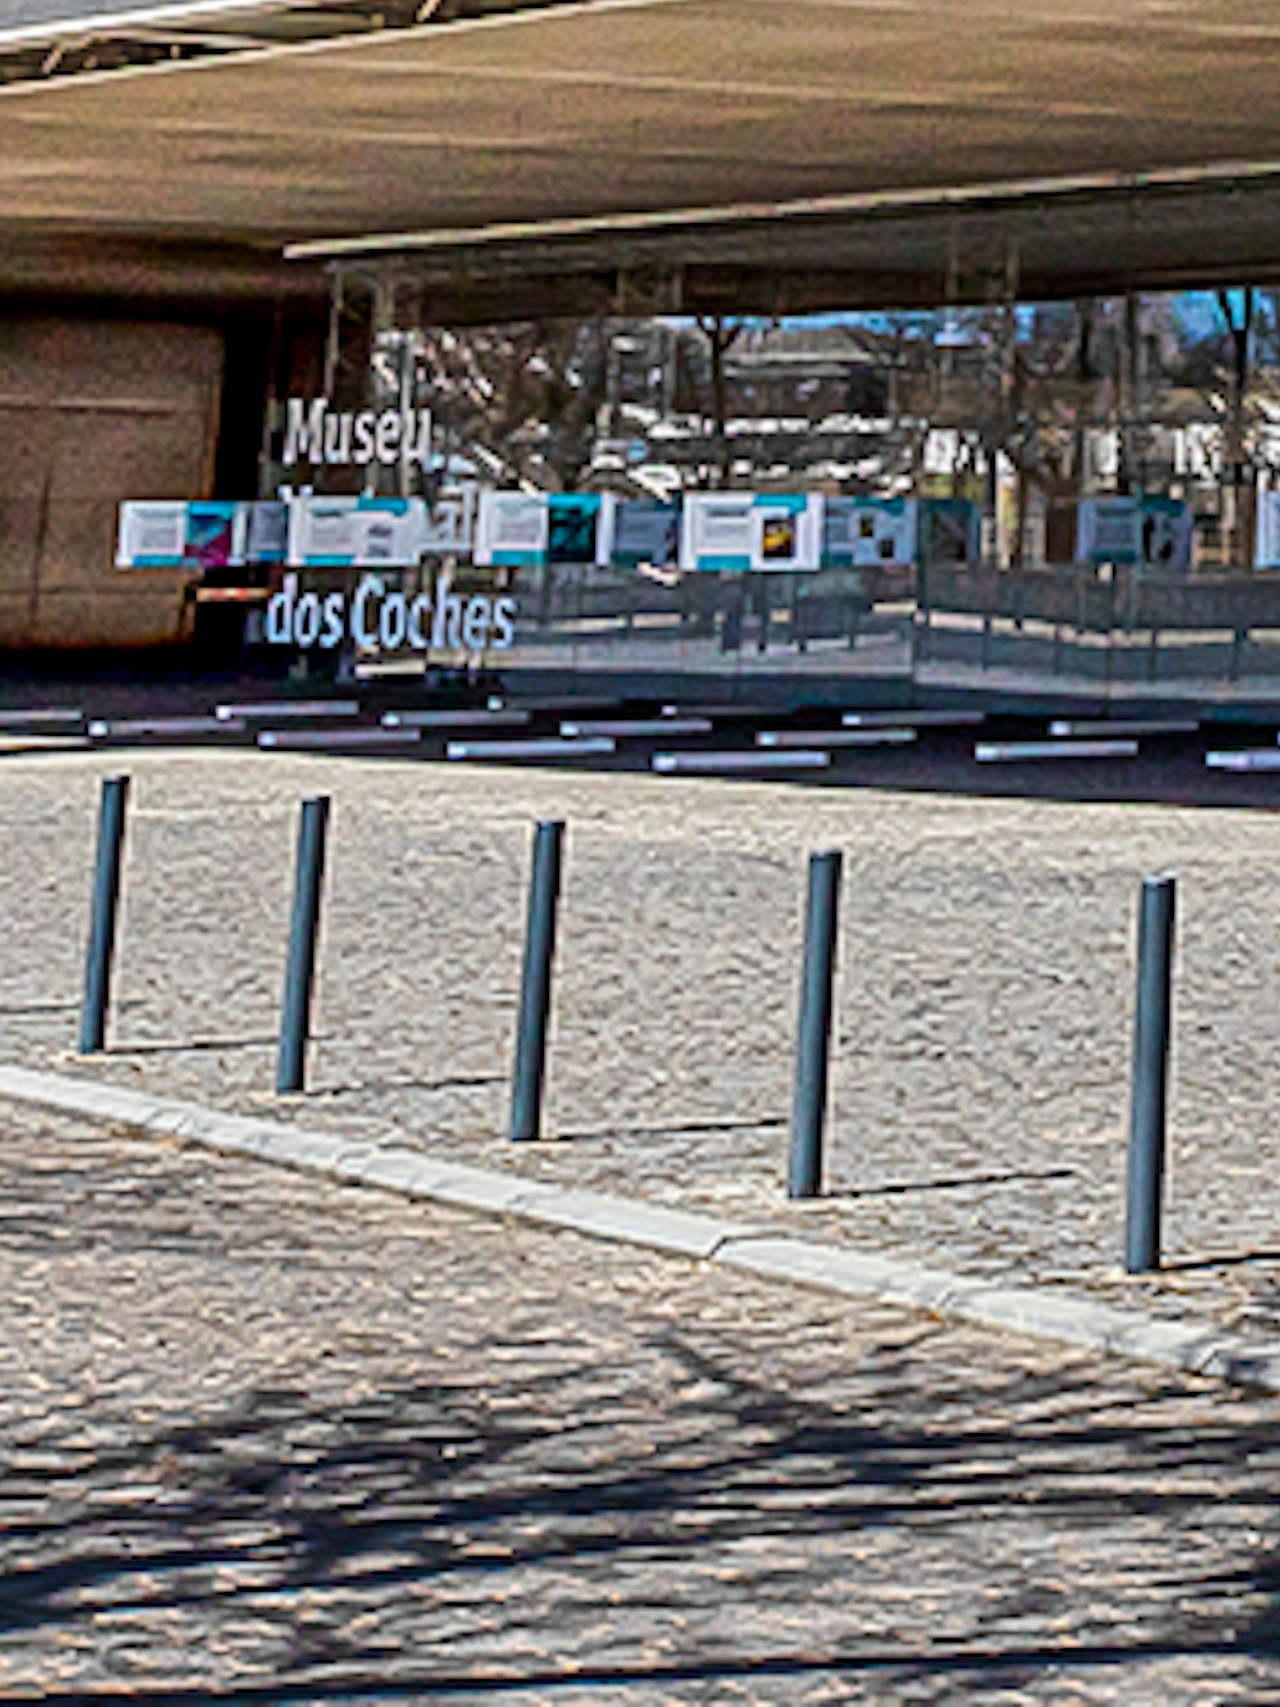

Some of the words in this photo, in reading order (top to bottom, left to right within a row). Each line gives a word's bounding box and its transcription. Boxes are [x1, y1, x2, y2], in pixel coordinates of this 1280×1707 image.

[282, 396, 432, 465] Museu
[266, 572, 344, 648] dos
[351, 573, 517, 649] Coches
